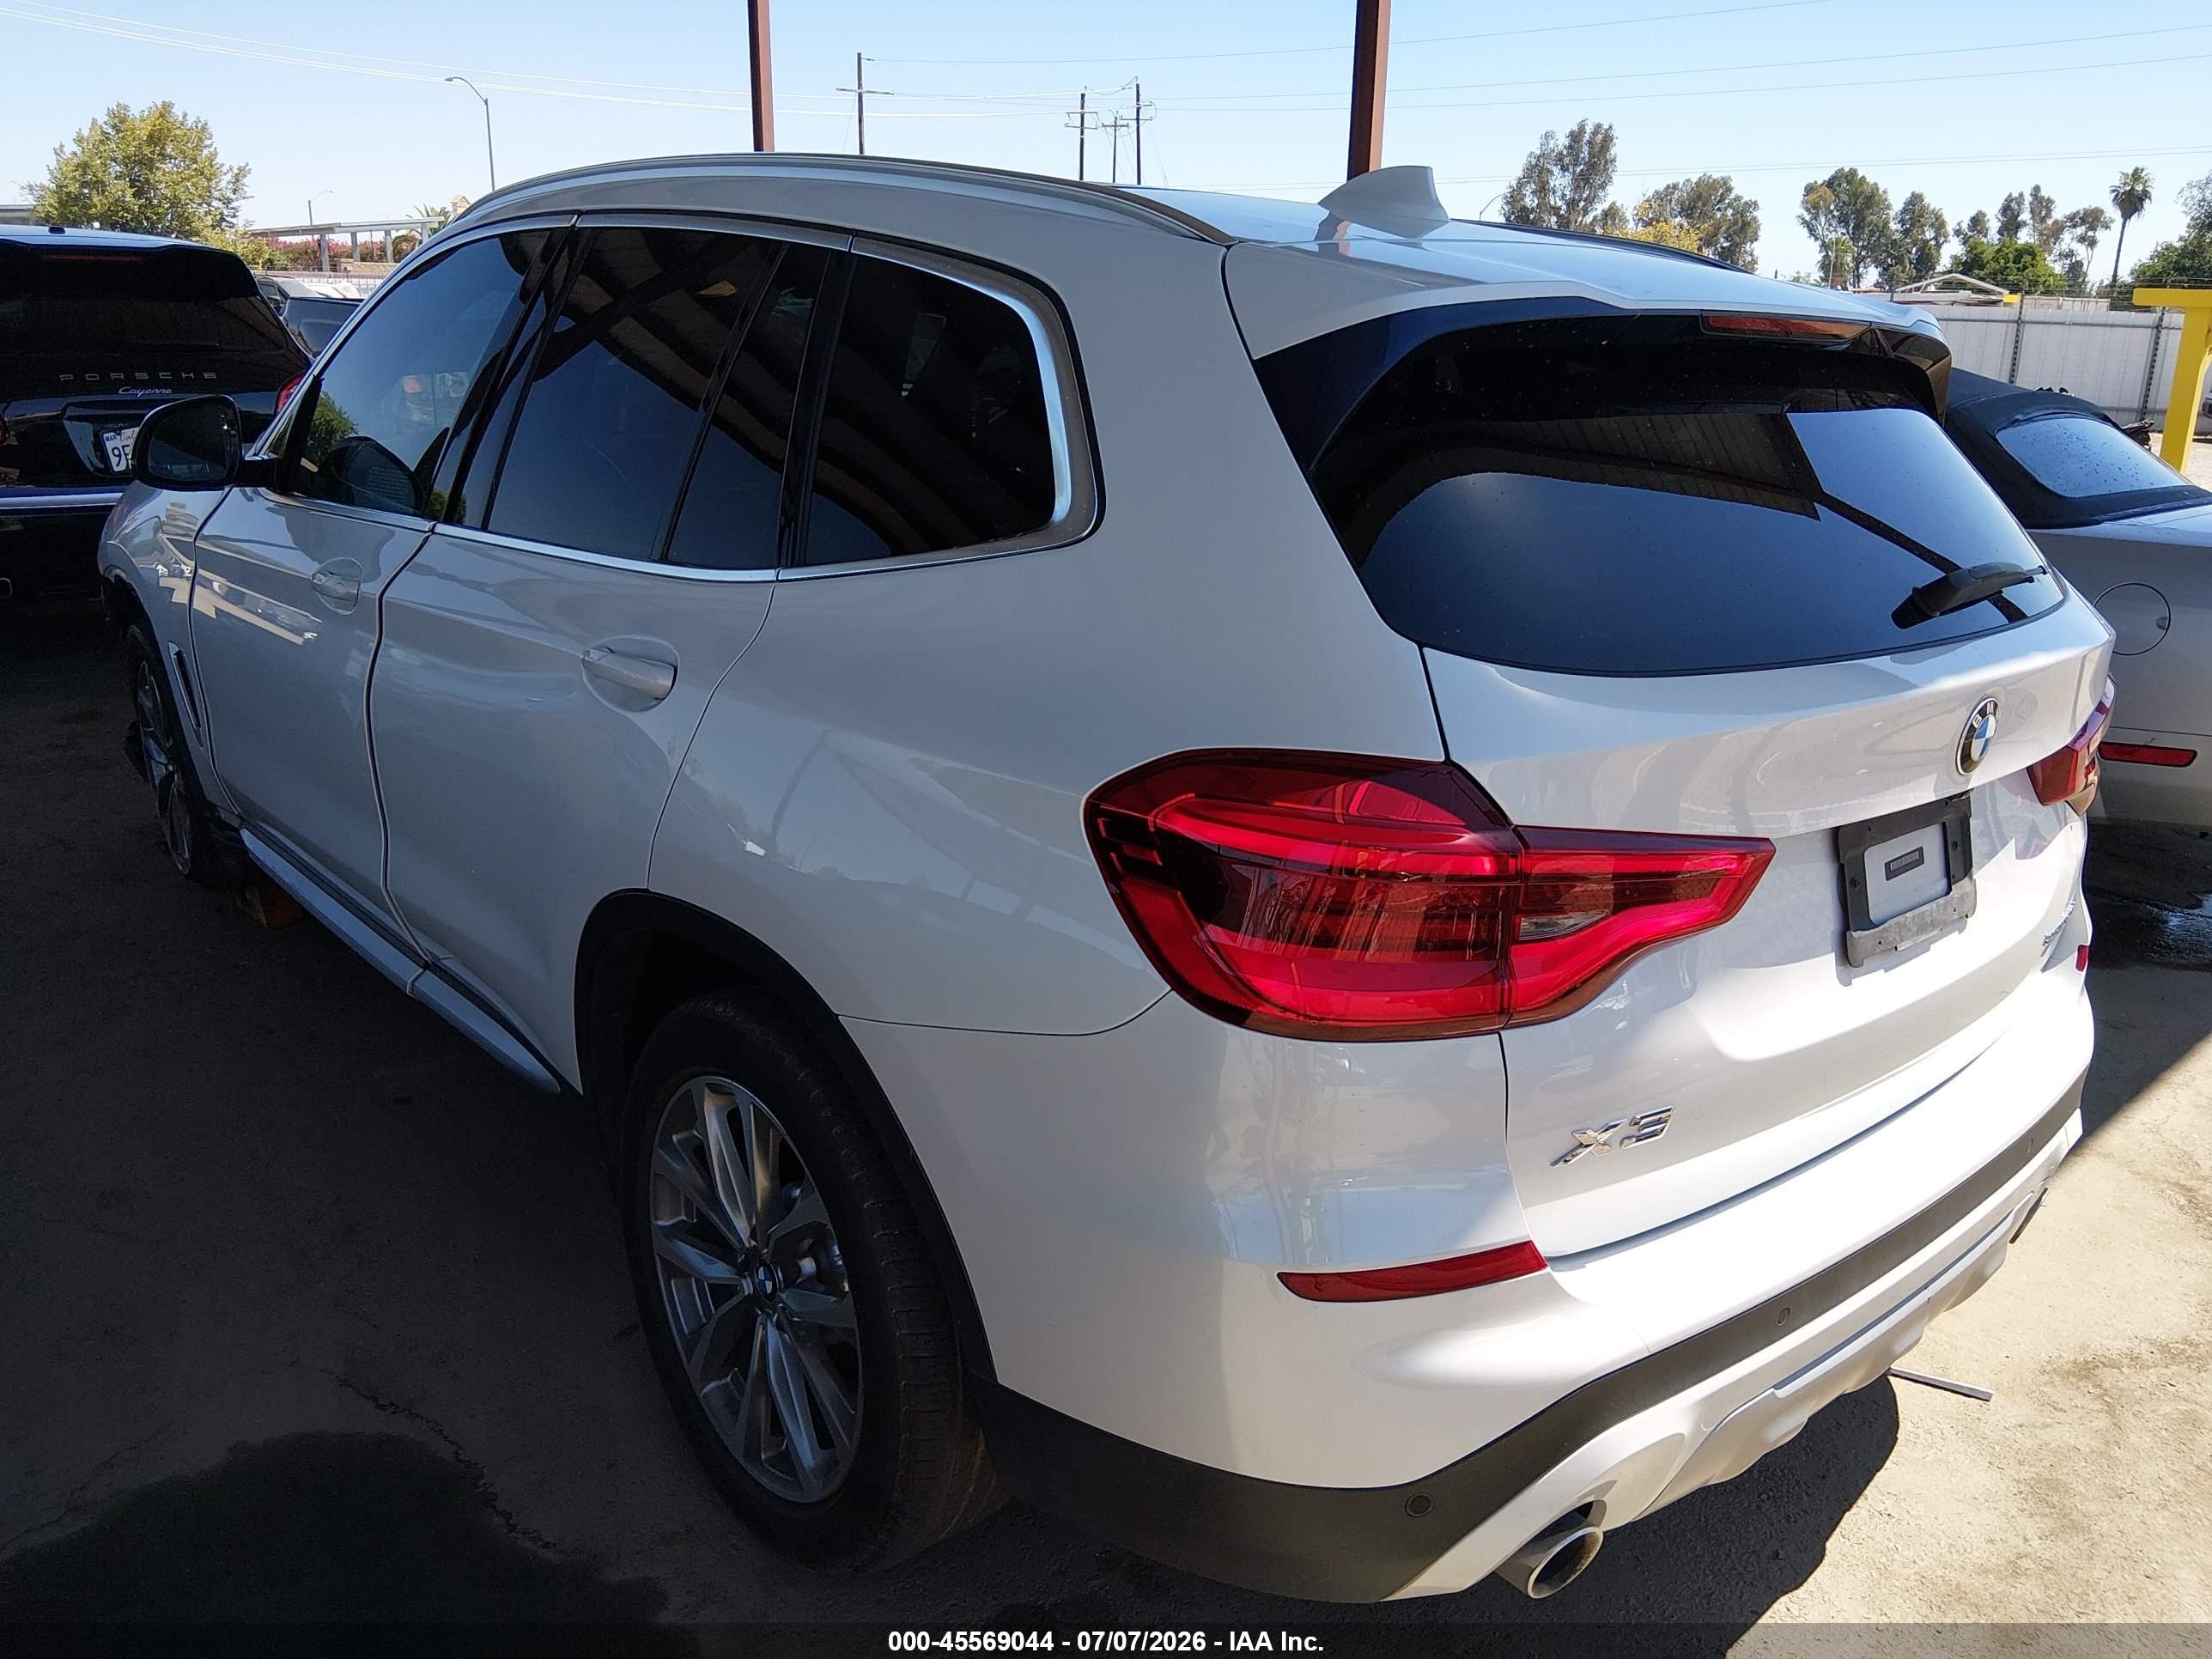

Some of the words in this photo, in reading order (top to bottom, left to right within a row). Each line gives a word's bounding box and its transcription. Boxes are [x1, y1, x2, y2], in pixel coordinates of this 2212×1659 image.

[59, 372, 217, 382] PORSCHE
[118, 386, 173, 397] Cayenne
[1550, 1106, 1675, 1167] X3
